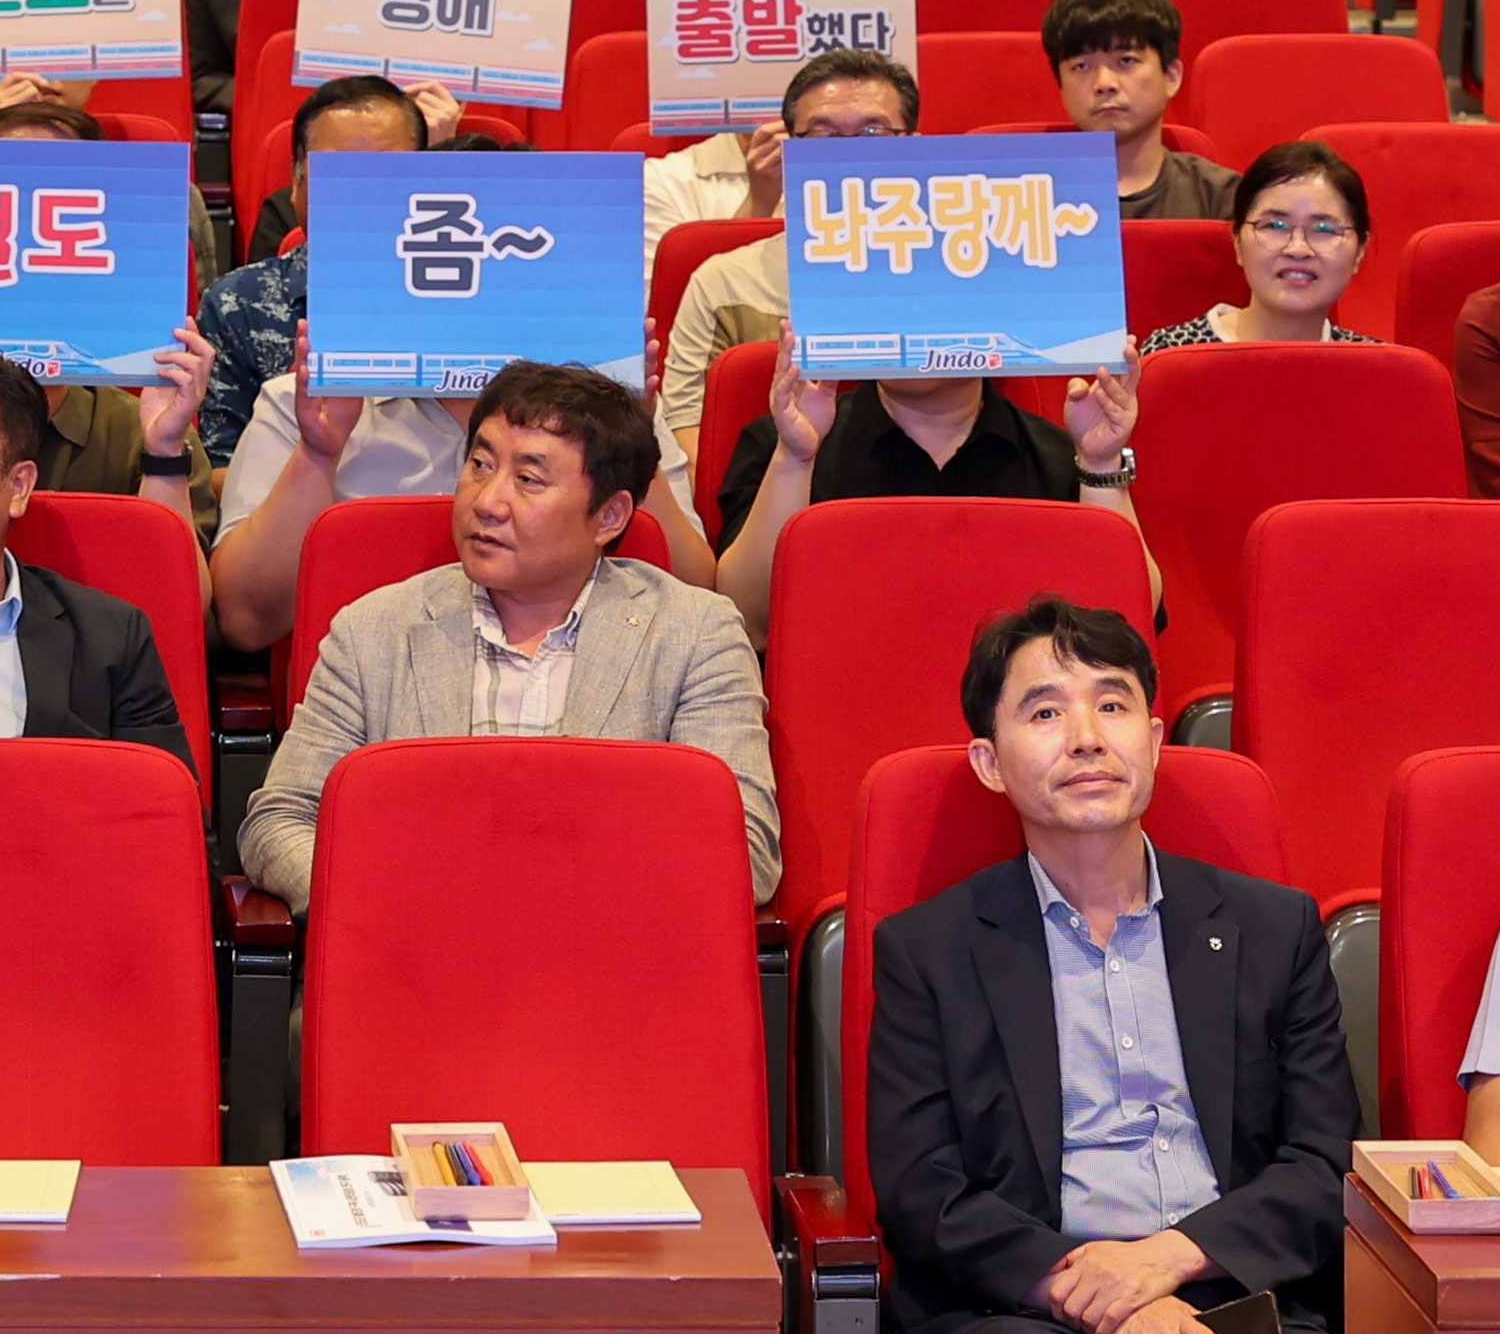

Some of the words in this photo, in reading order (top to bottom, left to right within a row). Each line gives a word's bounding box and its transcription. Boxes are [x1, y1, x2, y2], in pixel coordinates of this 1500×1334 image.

[399, 193, 554, 297] 좀~
[920, 349, 987, 371] Jindo
[435, 369, 490, 391] Jind
